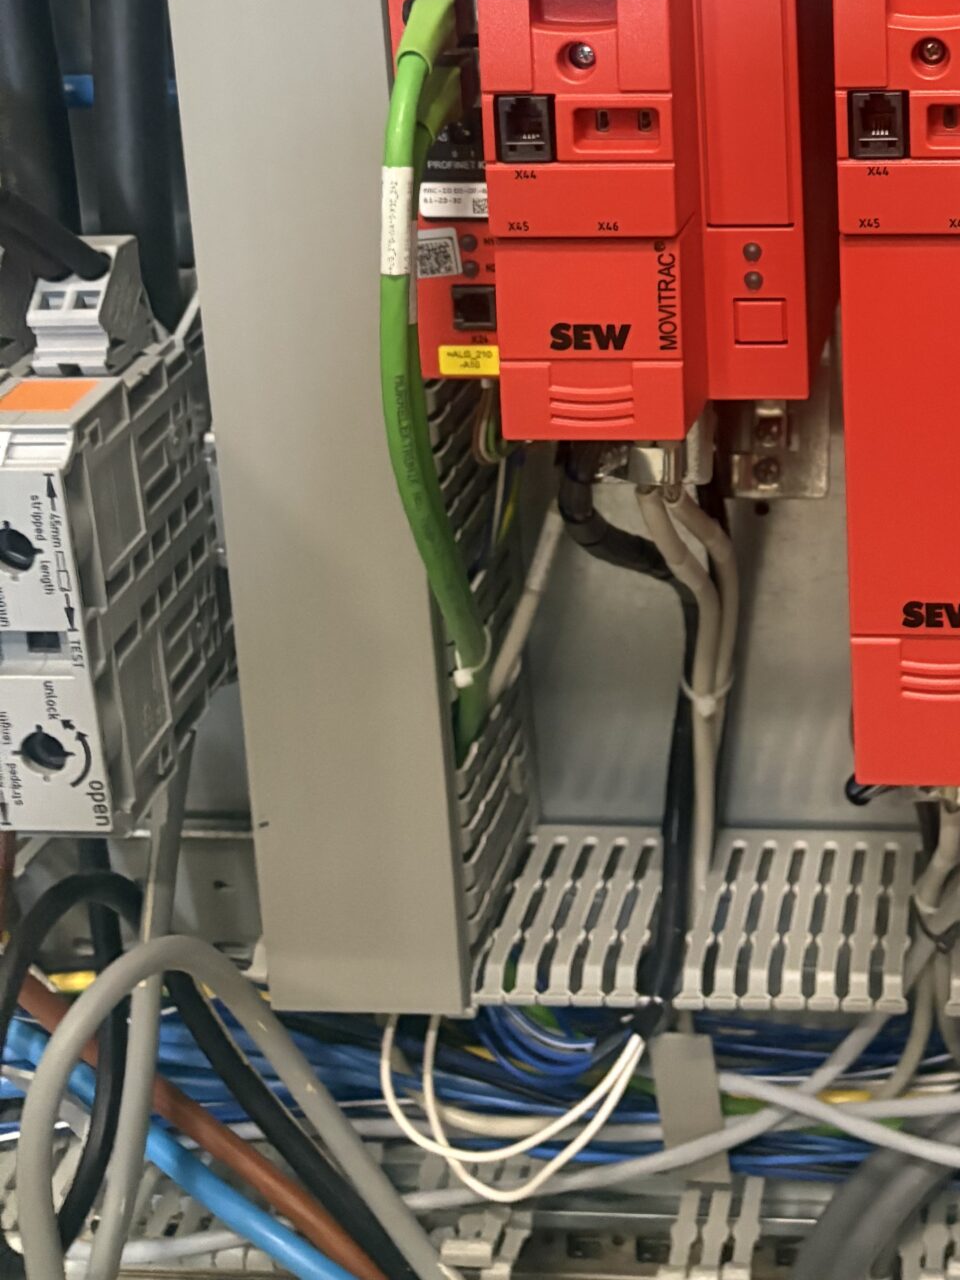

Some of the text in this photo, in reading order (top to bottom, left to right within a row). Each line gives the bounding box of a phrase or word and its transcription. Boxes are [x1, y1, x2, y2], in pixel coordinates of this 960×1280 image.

[514, 170, 537, 181] X44
[867, 166, 889, 176] X44
[507, 221, 530, 232] X45
[597, 222, 619, 232] X46
[858, 219, 881, 229] X45
[549, 322, 631, 351] SEW
[30, 494, 56, 595] stripped length
[69, 639, 84, 669] TEST
[43, 680, 60, 720] unlock
[86, 780, 110, 826] open
